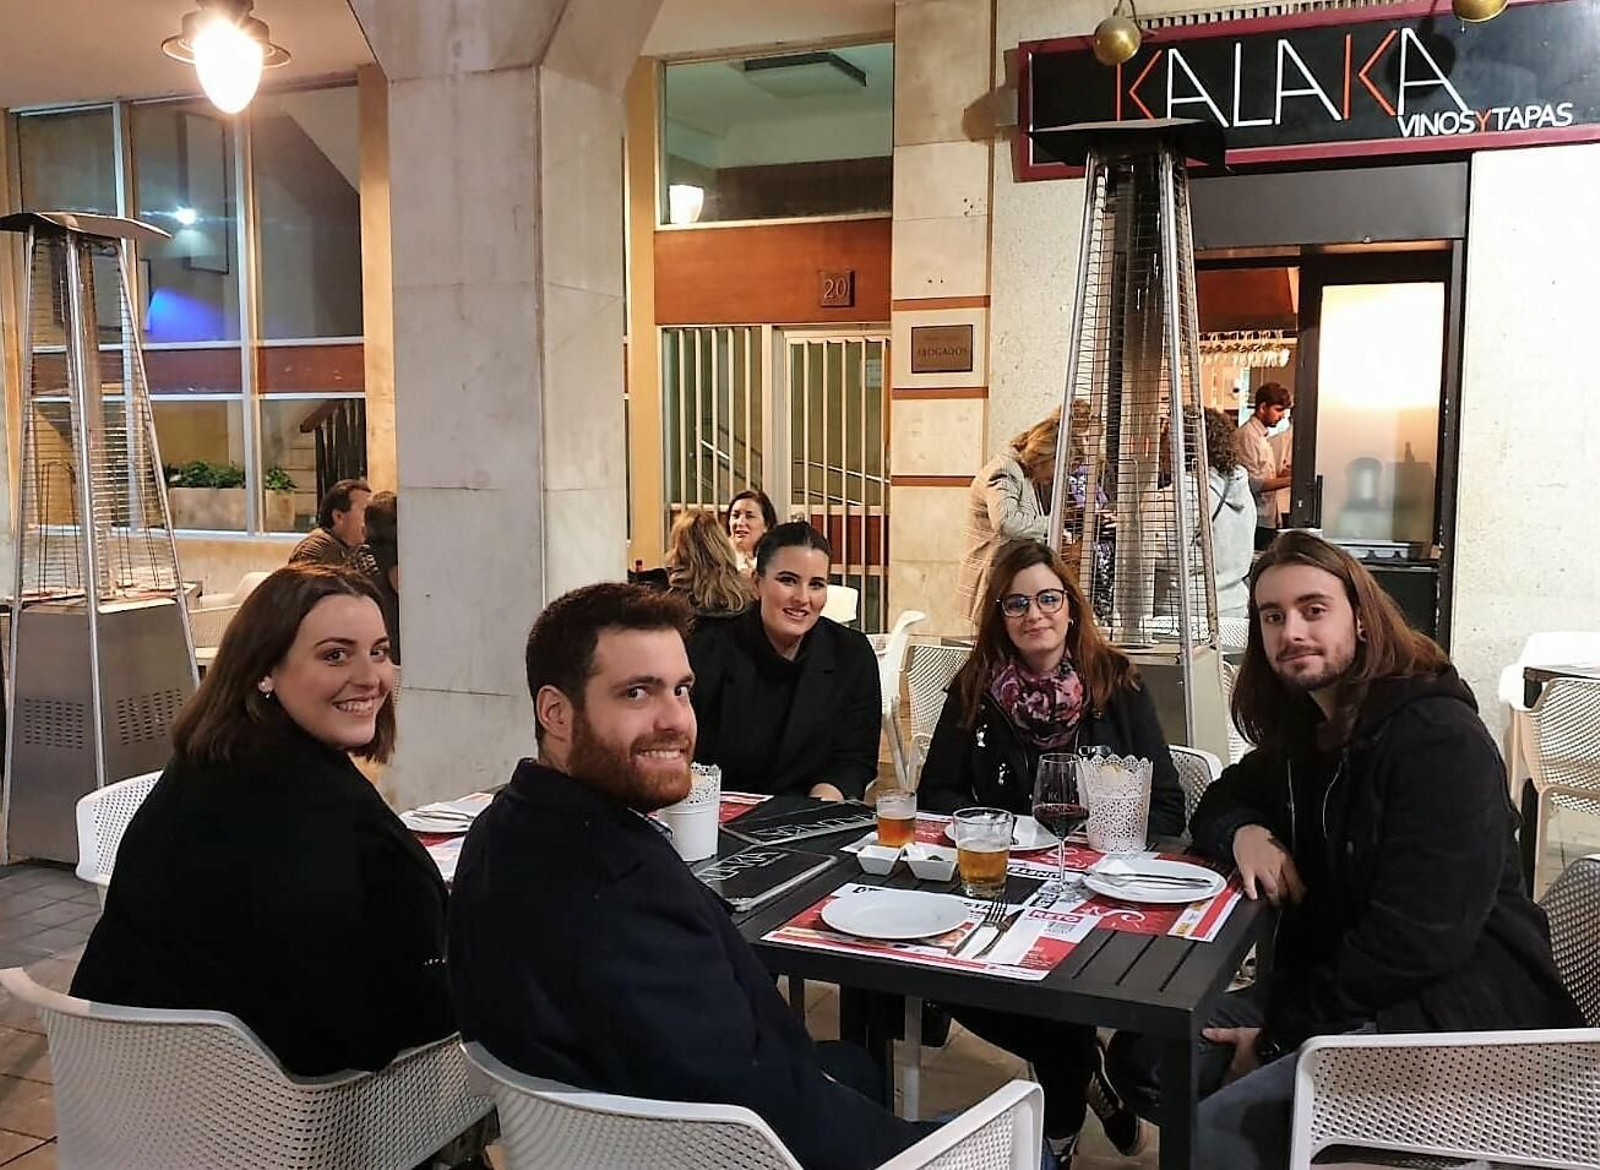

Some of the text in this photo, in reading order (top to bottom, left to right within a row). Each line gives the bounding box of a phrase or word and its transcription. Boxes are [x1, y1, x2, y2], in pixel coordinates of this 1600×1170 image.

[1115, 28, 1470, 127] KALAKA
[823, 278, 848, 299] 20
[1030, 910, 1083, 922] RETO
